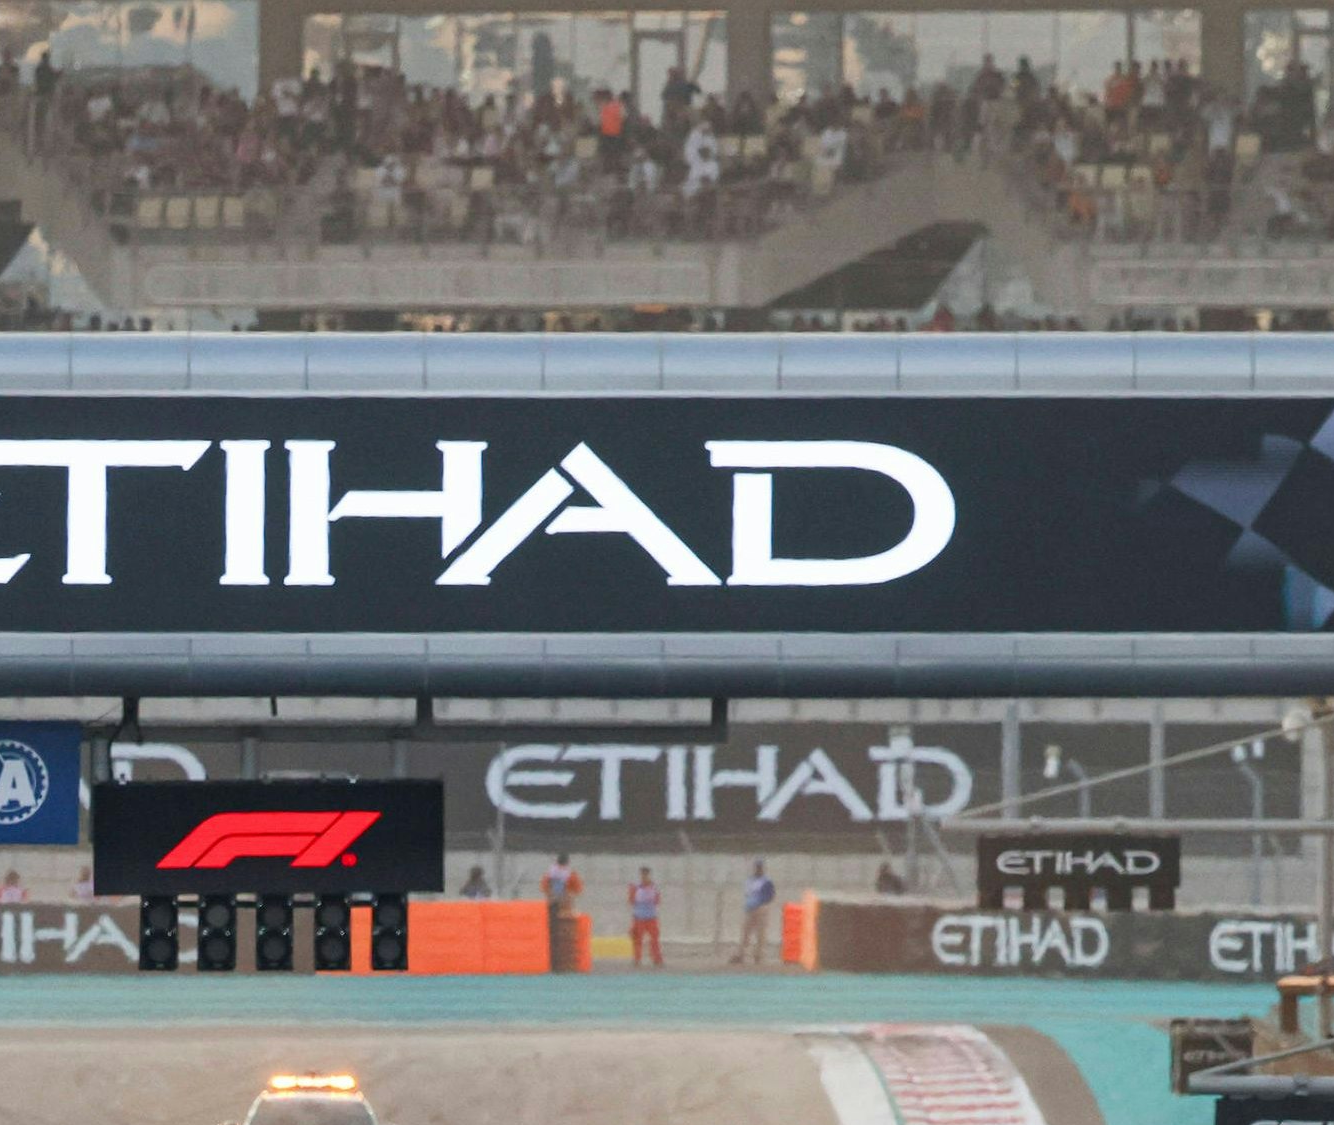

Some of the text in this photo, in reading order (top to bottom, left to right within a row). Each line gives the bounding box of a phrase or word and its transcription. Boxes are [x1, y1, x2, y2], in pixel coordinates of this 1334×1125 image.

[485, 744, 972, 820] ETIHAD
[157, 811, 381, 868] F1
[996, 850, 1161, 875] ETIHAD
[931, 915, 1109, 967] ETIHAD
